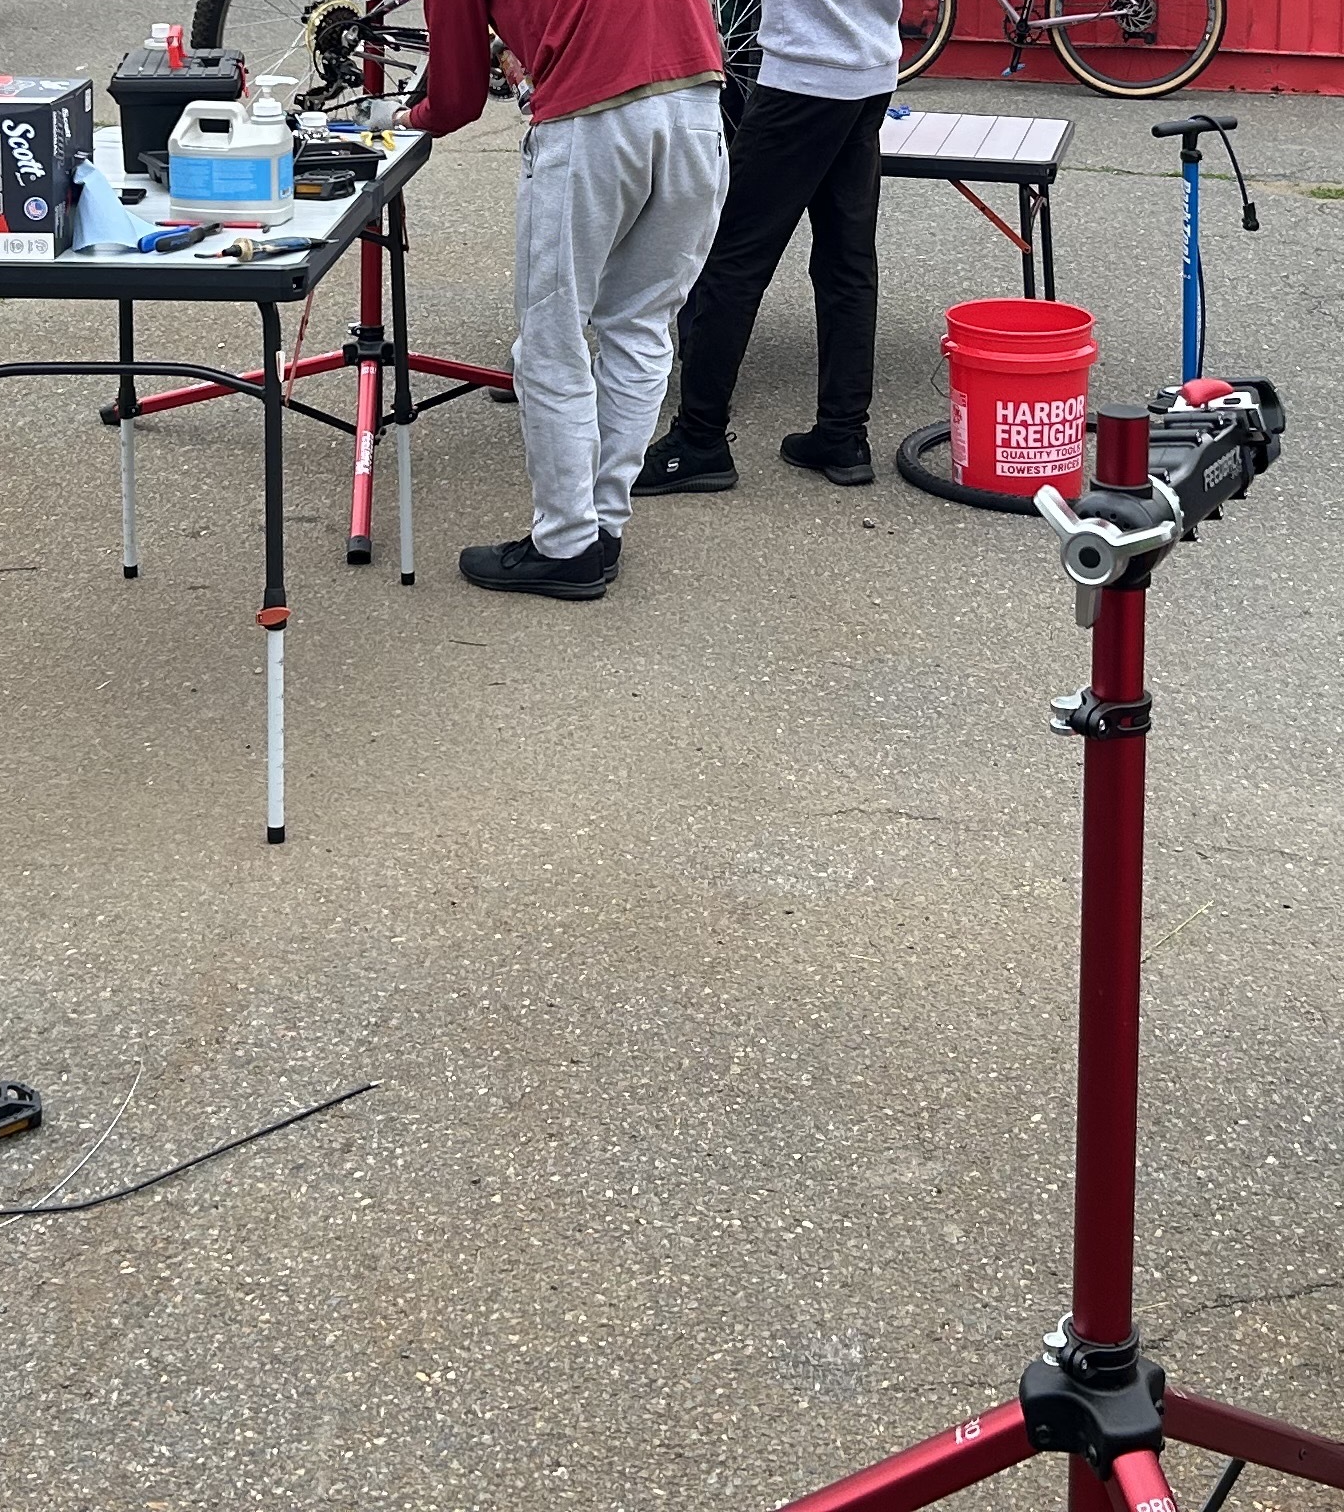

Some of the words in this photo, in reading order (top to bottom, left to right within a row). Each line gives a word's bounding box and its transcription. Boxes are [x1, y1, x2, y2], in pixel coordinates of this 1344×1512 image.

[2, 118, 47, 183] Scott
[996, 394, 1086, 424] HARBOR
[995, 417, 1085, 448] FREIGHT
[1000, 448, 1052, 461] QUALITY
[1055, 444, 1081, 458] TOOLS
[1000, 463, 1049, 476] LOWEST
[1050, 459, 1081, 474] PRICES
